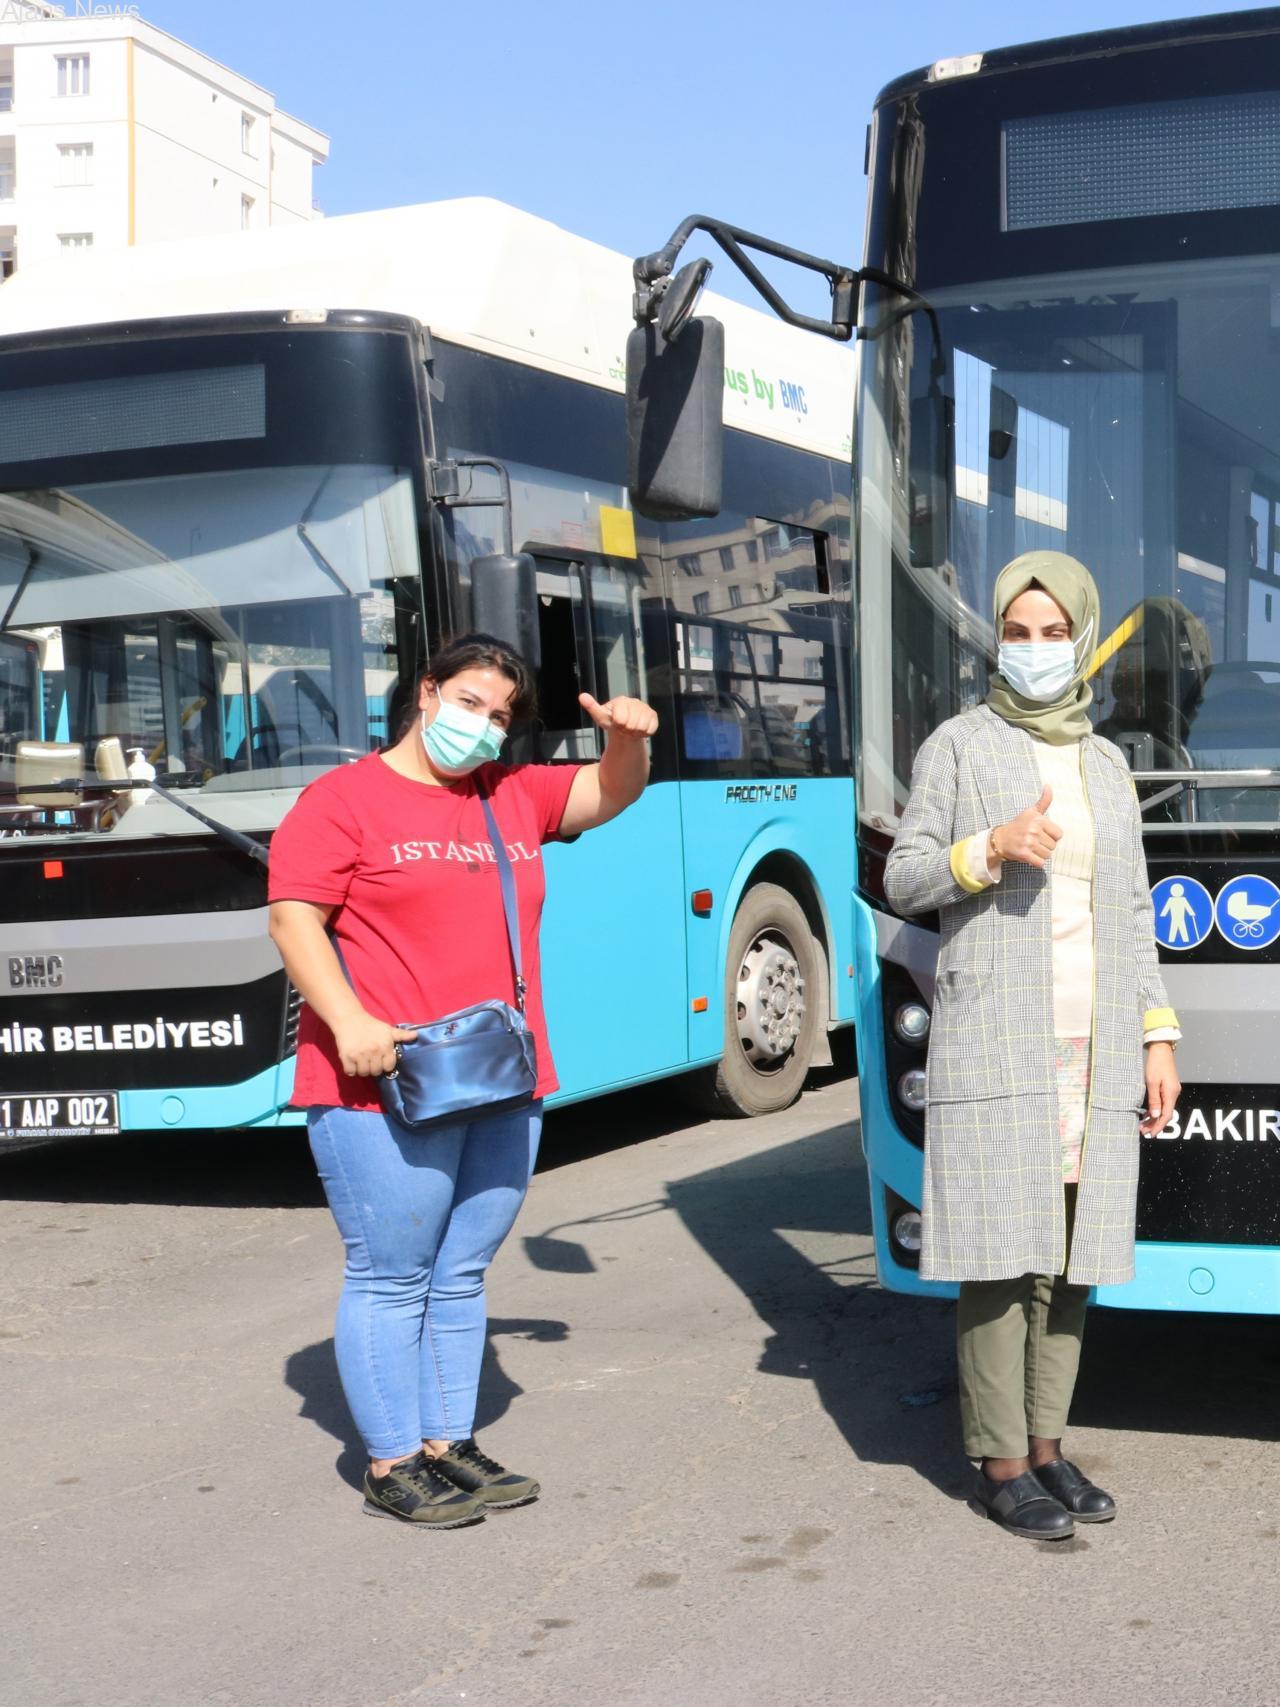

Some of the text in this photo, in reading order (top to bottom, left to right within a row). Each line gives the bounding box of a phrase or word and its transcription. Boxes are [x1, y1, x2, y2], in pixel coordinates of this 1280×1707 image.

[725, 367, 808, 415] us by BMC
[774, 784, 797, 802] CNG
[8, 956, 64, 988] BMC
[52, 1013, 244, 1052] BELEDİYESİ
[0, 1097, 108, 1127] 1 AAP 002
